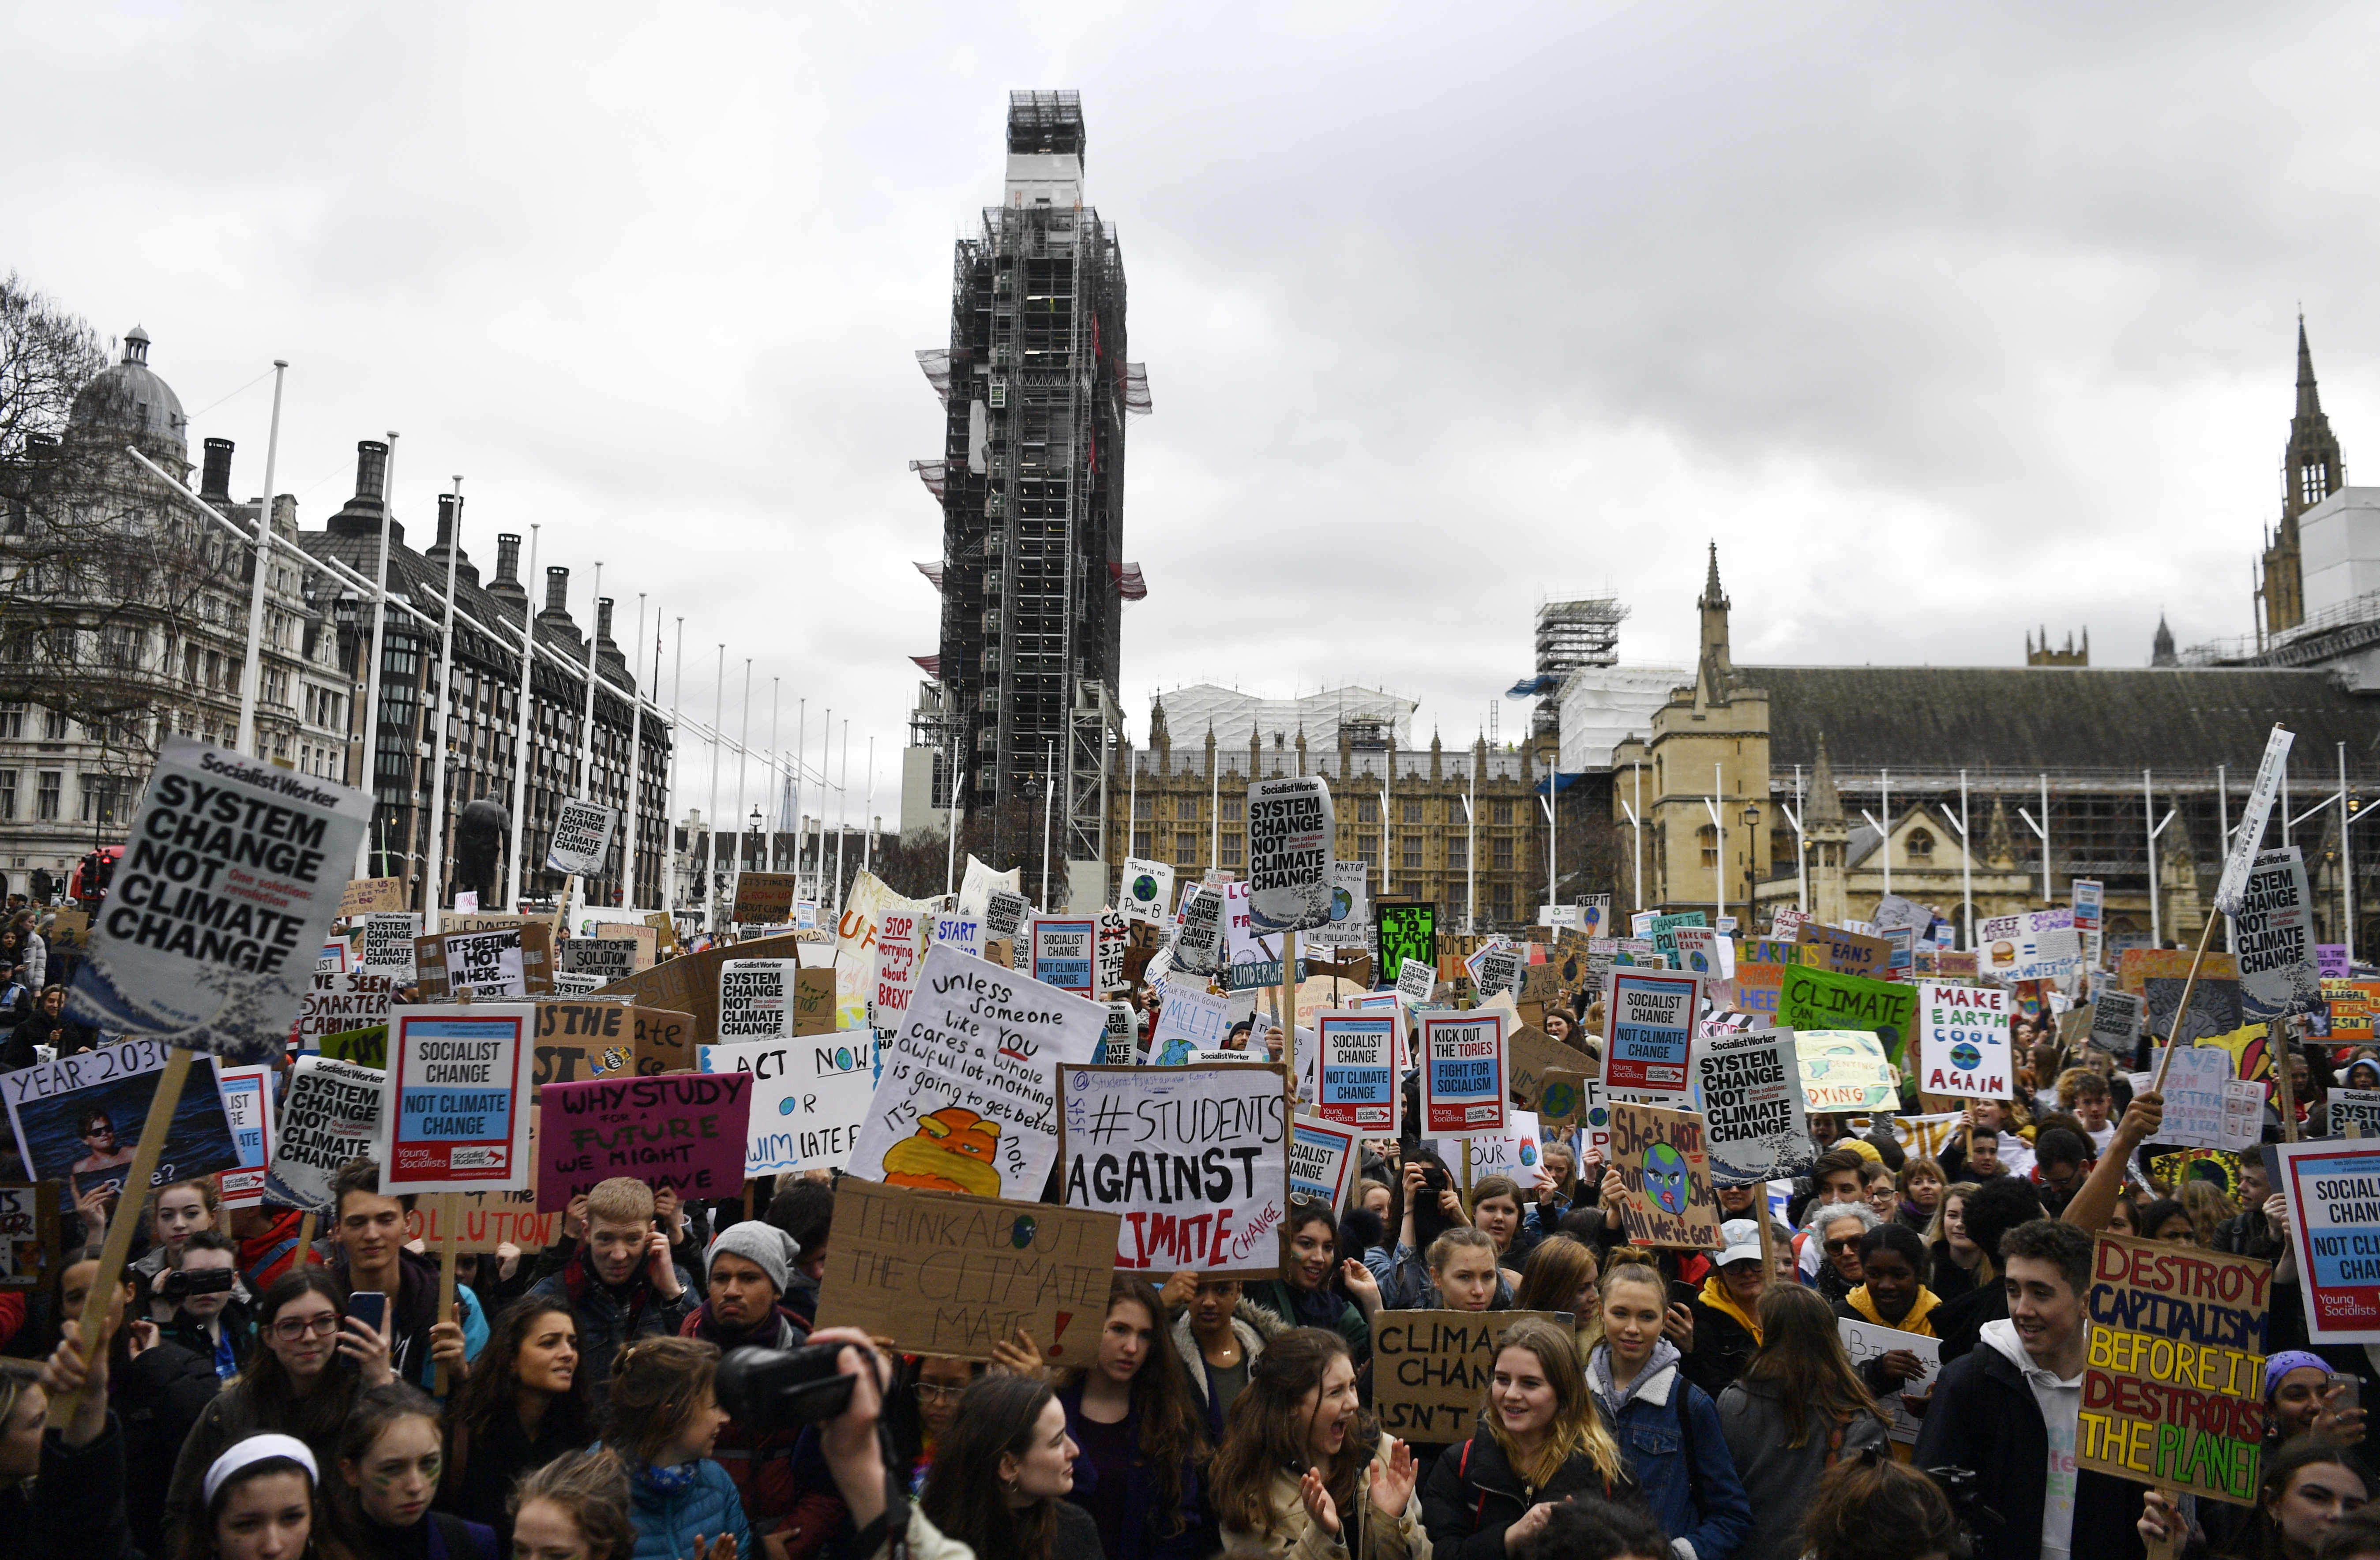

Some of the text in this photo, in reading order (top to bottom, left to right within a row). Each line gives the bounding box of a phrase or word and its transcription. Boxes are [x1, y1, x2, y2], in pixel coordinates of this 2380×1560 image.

[155, 773, 328, 848] SYSTEM
[564, 806, 605, 824] SYSTEM
[1250, 797, 1320, 819] SYSTEM
[559, 823, 582, 835] NOT
[562, 815, 605, 832] CHANGE
[1251, 814, 1323, 837] CHANGE
[145, 808, 325, 883] CHANGE
[555, 840, 598, 856] CHANGE
[556, 832, 601, 849] CLIMATE
[1251, 836, 1286, 855] NOT
[130, 839, 226, 889] NOT
[1128, 862, 1147, 873] There
[1252, 849, 1325, 873] CLIMATE
[1336, 863, 1363, 872] PART OF
[1252, 867, 1323, 891] CHANGE
[740, 891, 774, 900] GROW
[1577, 895, 1609, 907] KEEP IT
[119, 874, 306, 949] CLIMATE
[736, 902, 763, 912] ABOUT
[1124, 897, 1161, 918] Planet B
[1382, 908, 1430, 920] HERE
[1780, 910, 1809, 920] STOP
[886, 917, 977, 941] STOP START
[1351, 922, 1362, 931] OF
[1394, 920, 1419, 932] TO
[1686, 915, 1702, 926] THE
[1989, 917, 2020, 931] BEEF
[106, 909, 292, 975] CHANGE
[635, 928, 655, 938] SCHOOL
[1044, 934, 1084, 945] SOCIALIST
[1309, 933, 1321, 941] THE
[1383, 931, 1431, 944] TEACH
[447, 939, 470, 953] IT'S
[568, 940, 638, 951] BE PART OF THE
[878, 942, 912, 967] worrying
[1048, 946, 1080, 956] CHANGE
[1438, 935, 1465, 955] HOME
[1591, 941, 1650, 952] STOP DENYING
[1745, 941, 1820, 966] EARTH IS
[464, 949, 504, 967] HOT
[577, 951, 626, 966] SOLUTION
[1038, 963, 1088, 972] NOT CLIMATE
[1099, 956, 1123, 970] THE
[347, 975, 391, 993] SEEN
[451, 971, 465, 986] IN
[882, 967, 907, 982] about
[1047, 975, 1078, 984] CHANGE
[1101, 971, 1124, 988] AIR
[933, 972, 1012, 1003] unless
[1169, 986, 1227, 1010] WE'RE ALL GONNA
[302, 993, 387, 1015] SMARTER
[1791, 980, 1907, 1025] CLIMATE
[1935, 987, 2001, 1010] MAKE
[534, 1005, 558, 1038] IS
[561, 1006, 623, 1037] THE
[1161, 999, 1221, 1040] MELT!
[1791, 1006, 1813, 1020] CAN
[1932, 1009, 2008, 1028] EARTH
[2332, 1017, 2371, 1028] ISN'T
[911, 1023, 968, 1054] cares
[975, 1048, 986, 1059] a
[945, 1011, 1039, 1057] like YOU
[1435, 1028, 1481, 1042] KICK OUT
[1933, 1028, 2001, 1045] COOL
[419, 1042, 500, 1061] SOCIALIST
[1435, 1041, 1493, 1058] THE TORIES
[737, 1044, 867, 1080] ACT NOW
[1439, 1062, 1489, 1078] FIGHT FOR
[1700, 1048, 1778, 1074] SYSTEM
[11, 1060, 92, 1100] YEAR:
[426, 1064, 491, 1083] CHANGE
[1703, 1065, 1785, 1091] CHANGE
[1929, 1069, 2004, 1092] AGAIN
[562, 1076, 745, 1114] WHY STUDY
[893, 1062, 907, 1080] is
[908, 1071, 961, 1106] going
[966, 1090, 983, 1106] to
[983, 1101, 1012, 1119] get
[1437, 1077, 1491, 1093] SOCIALISM
[405, 1094, 506, 1113] NOT CLIMATE
[993, 1076, 1053, 1120] nothing
[1705, 1089, 1746, 1109] NOT
[1808, 1088, 1862, 1104] DYING
[883, 1099, 917, 1131] IT'S
[1089, 1095, 1284, 1145] #STUDENTS
[1708, 1099, 1792, 1126] CLIMATE
[423, 1116, 485, 1135] CHANGE
[570, 1115, 720, 1151] FUTURE
[1616, 1108, 1701, 1155] She's HOT
[1710, 1117, 1791, 1143] CHANGE
[556, 1144, 695, 1173] WE MIGHT
[1470, 1144, 1506, 1166] OUR
[1066, 1148, 1262, 1206] AGAINST
[1616, 1164, 1644, 1193] BUT
[839, 1190, 959, 1247] THINK
[1622, 1203, 1647, 1240] All
[1232, 1200, 1281, 1260] CHANGE
[852, 1249, 1104, 1308] THE CLIMATE
[2096, 1238, 2272, 1306] DESTROY
[2088, 1283, 2268, 1354] CAPITALISM
[2088, 1326, 2266, 1400] BEFORE IT
[1378, 1403, 1468, 1430] ISN'T
[2084, 1369, 2264, 1445] DESTROYS
[2079, 1410, 2261, 1500] THE PLANET
